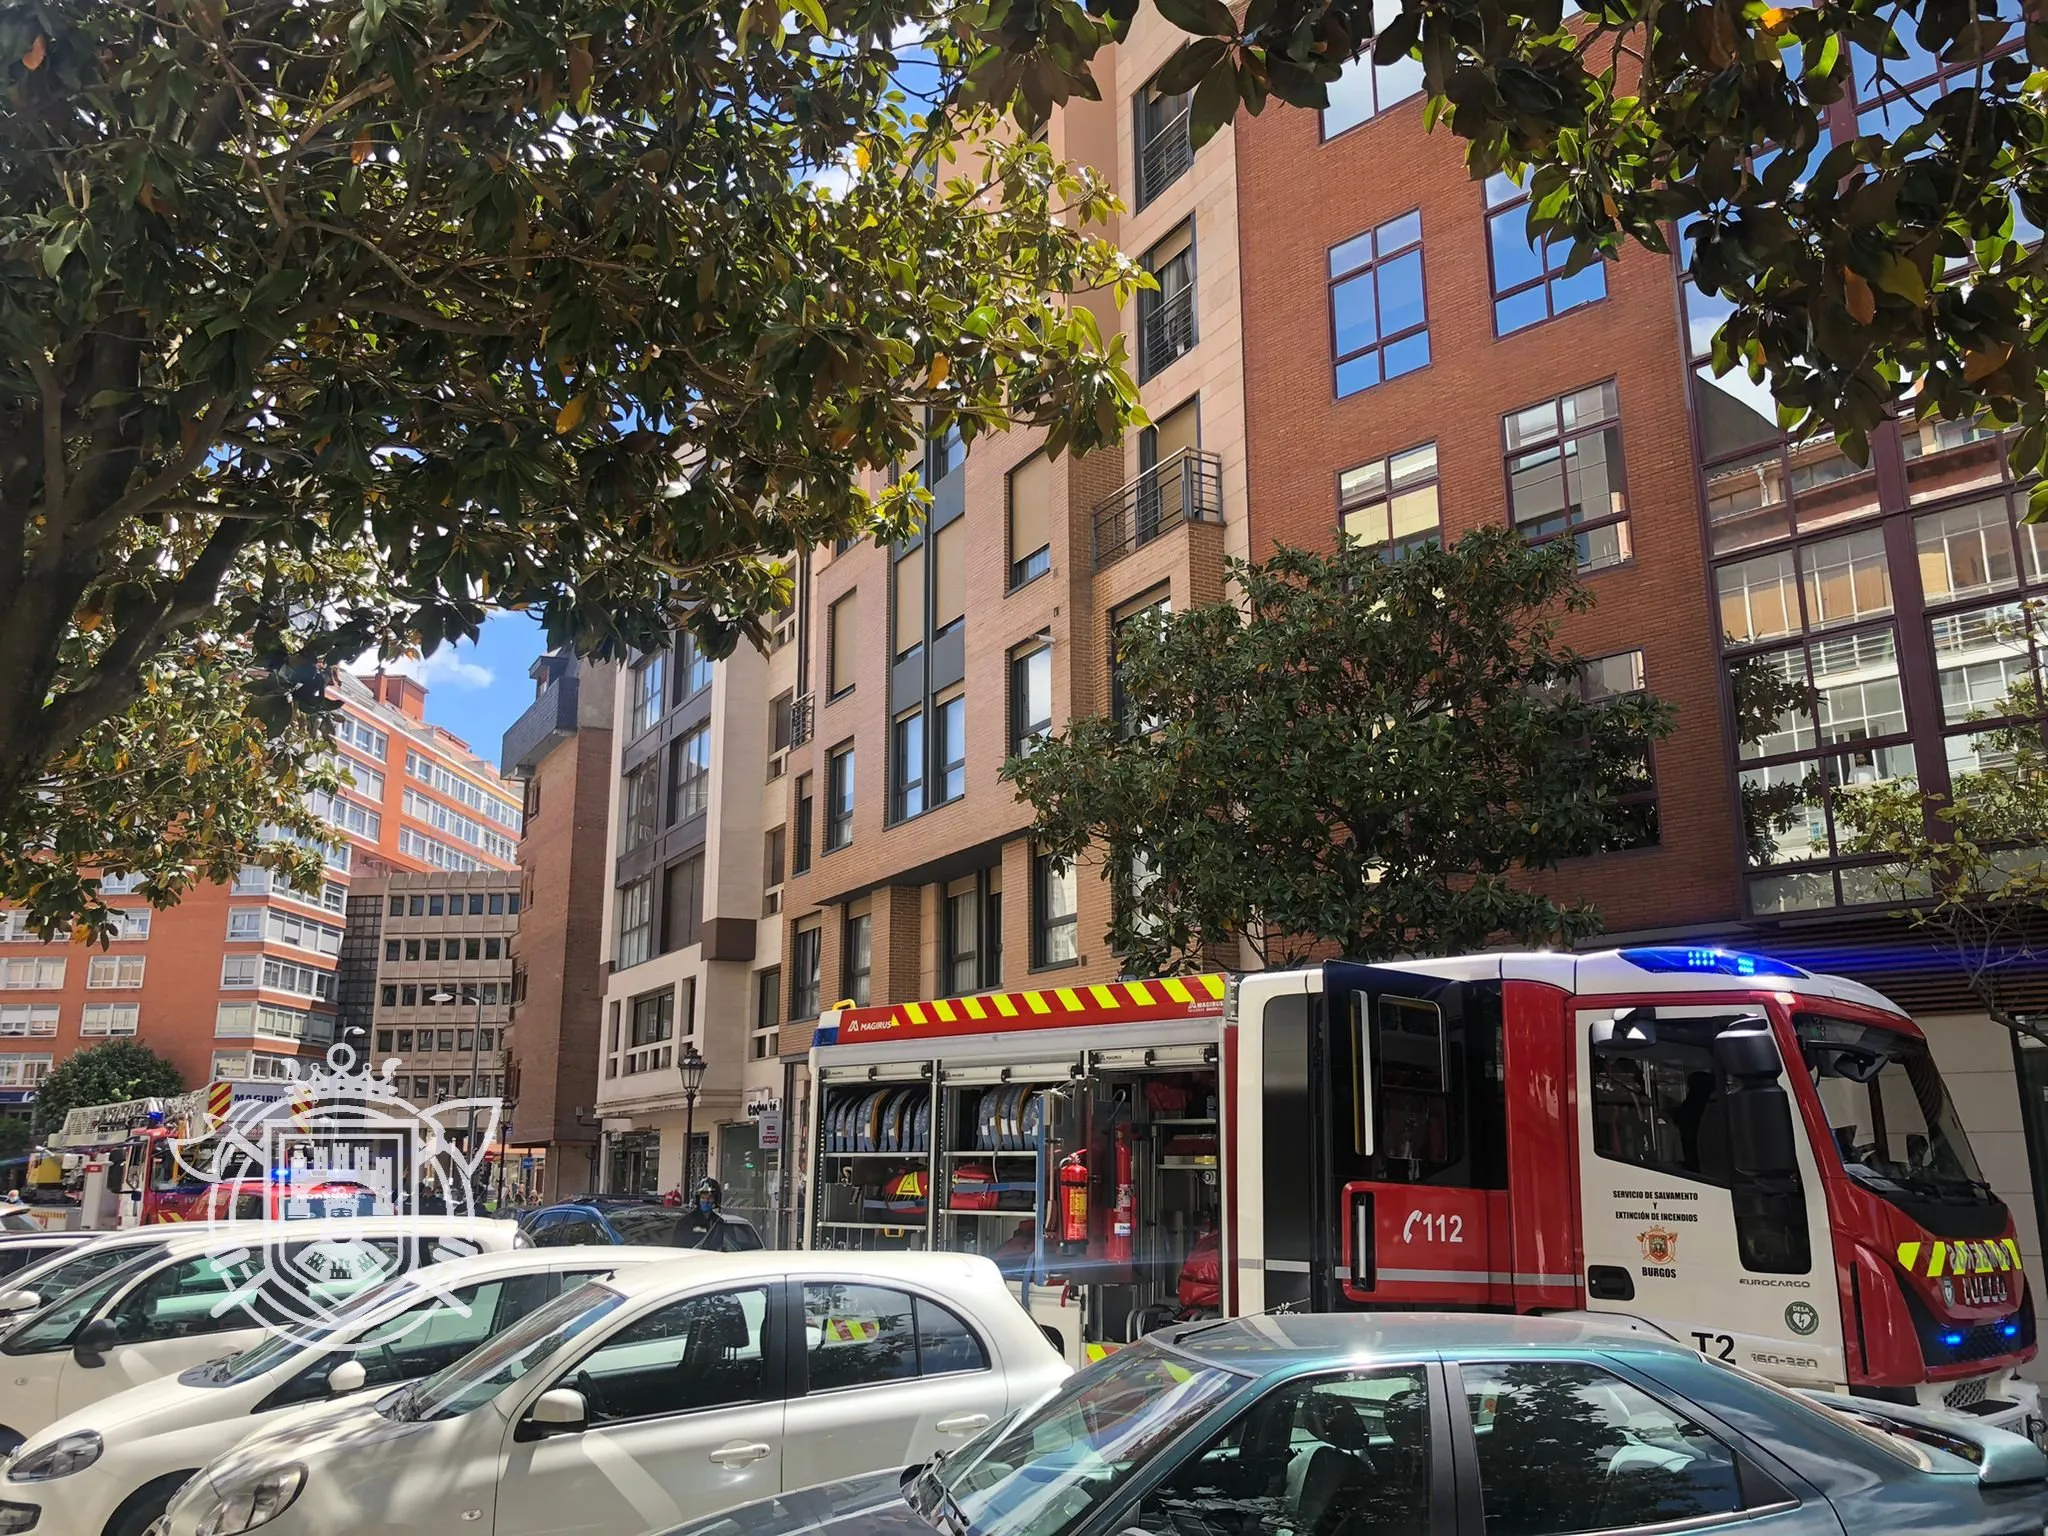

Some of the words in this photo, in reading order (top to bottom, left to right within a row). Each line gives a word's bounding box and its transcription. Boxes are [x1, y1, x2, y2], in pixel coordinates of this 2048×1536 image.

[860, 1021, 892, 1031] MAGIRUS
[1612, 1190, 1644, 1199] SERVICIO
[1645, 1191, 1653, 1199] DE
[1654, 1191, 1699, 1201] SALVAMENTO
[1653, 1202, 1658, 1210] Y
[1615, 1211, 1650, 1220] EXTINCIÓN
[1651, 1212, 1660, 1220] DE
[1661, 1213, 1698, 1222] INCENDIOS
[1423, 1213, 1463, 1243] 112
[1641, 1266, 1677, 1278] BURGOS
[1739, 1278, 1811, 1288] EUROCARGO
[1792, 1305, 1810, 1313] DESA
[1691, 1331, 1737, 1365] T2
[1751, 1353, 1818, 1369] 160-320
